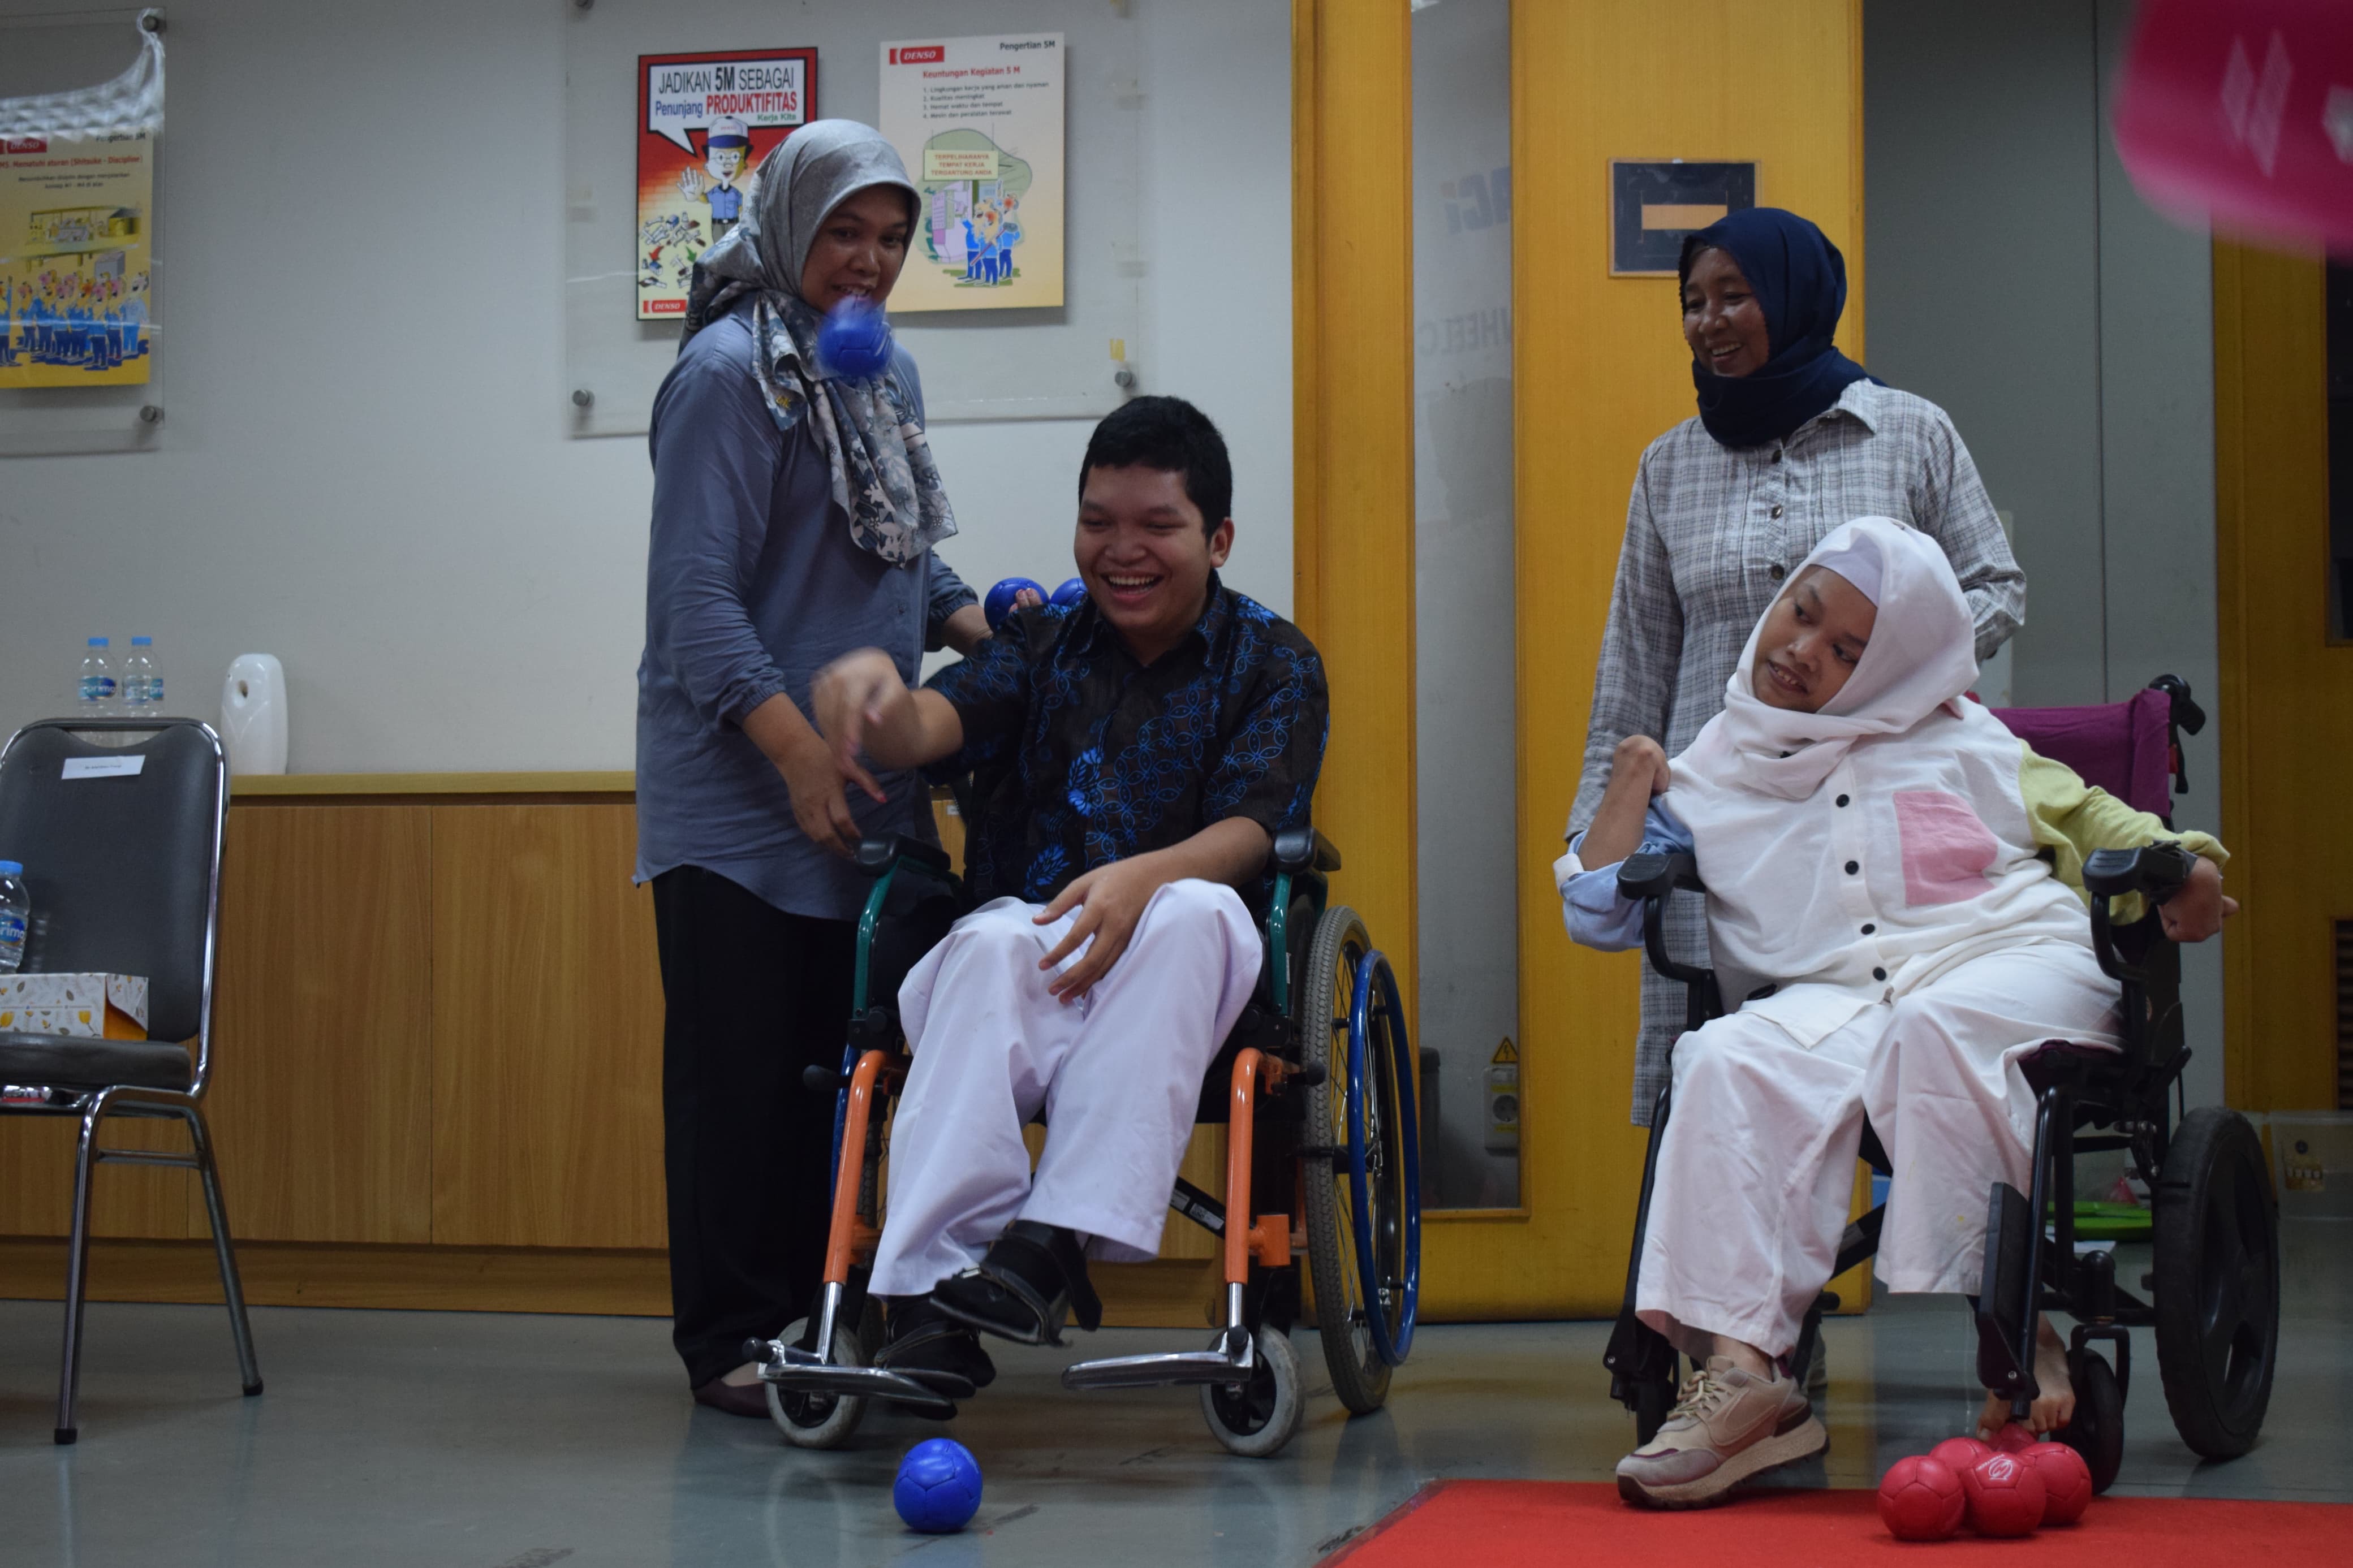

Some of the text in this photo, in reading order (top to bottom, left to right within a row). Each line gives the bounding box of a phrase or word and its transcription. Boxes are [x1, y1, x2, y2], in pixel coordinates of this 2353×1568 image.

[1000, 40, 1056, 52] Pengertian 5M
[904, 51, 937, 60] DENSO
[923, 70, 968, 79] Keuntungan
[971, 67, 1005, 77] Kegiatan
[659, 66, 794, 94] JADIKAN 5M SEBAGAI
[656, 91, 797, 118] Penunjang PRODUKTIFITAS
[757, 113, 796, 123] Kerja Kita
